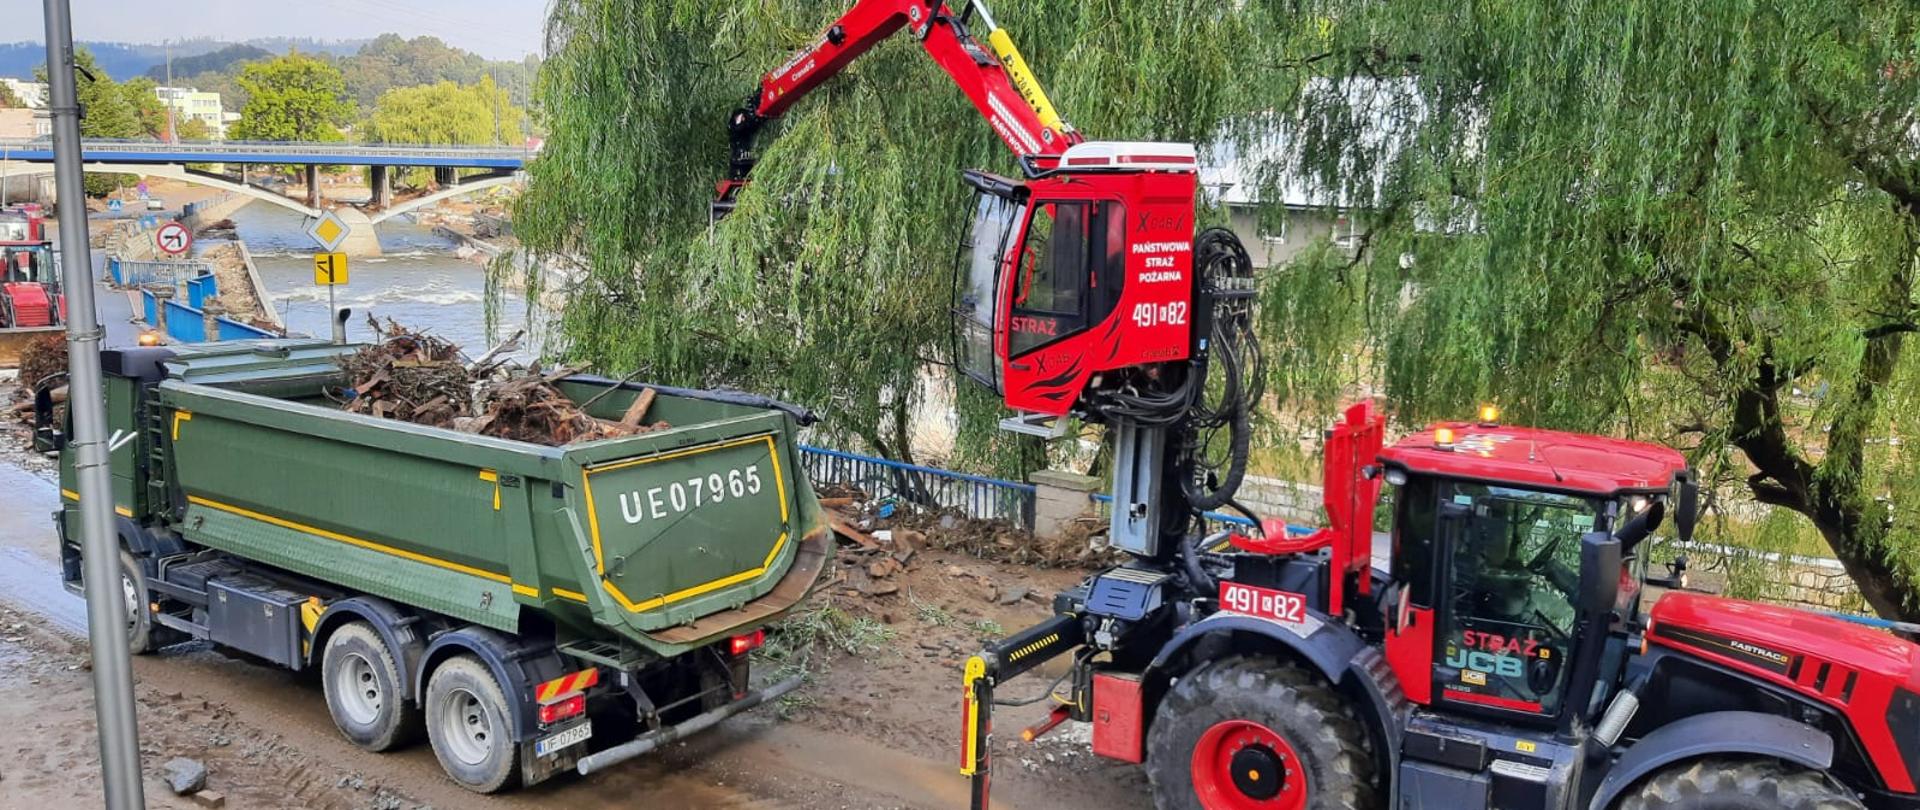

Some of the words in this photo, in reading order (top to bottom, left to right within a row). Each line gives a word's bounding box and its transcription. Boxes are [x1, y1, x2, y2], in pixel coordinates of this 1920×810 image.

[1132, 241, 1190, 254] PAŃSTWOWA
[1145, 254, 1174, 268] STRAŻ
[1138, 269, 1182, 284] POŻARNA
[1011, 316, 1057, 336] STRAŻ
[619, 465, 761, 524] UE07965
[1446, 648, 1523, 678] JCB
[560, 721, 591, 746] 07965
